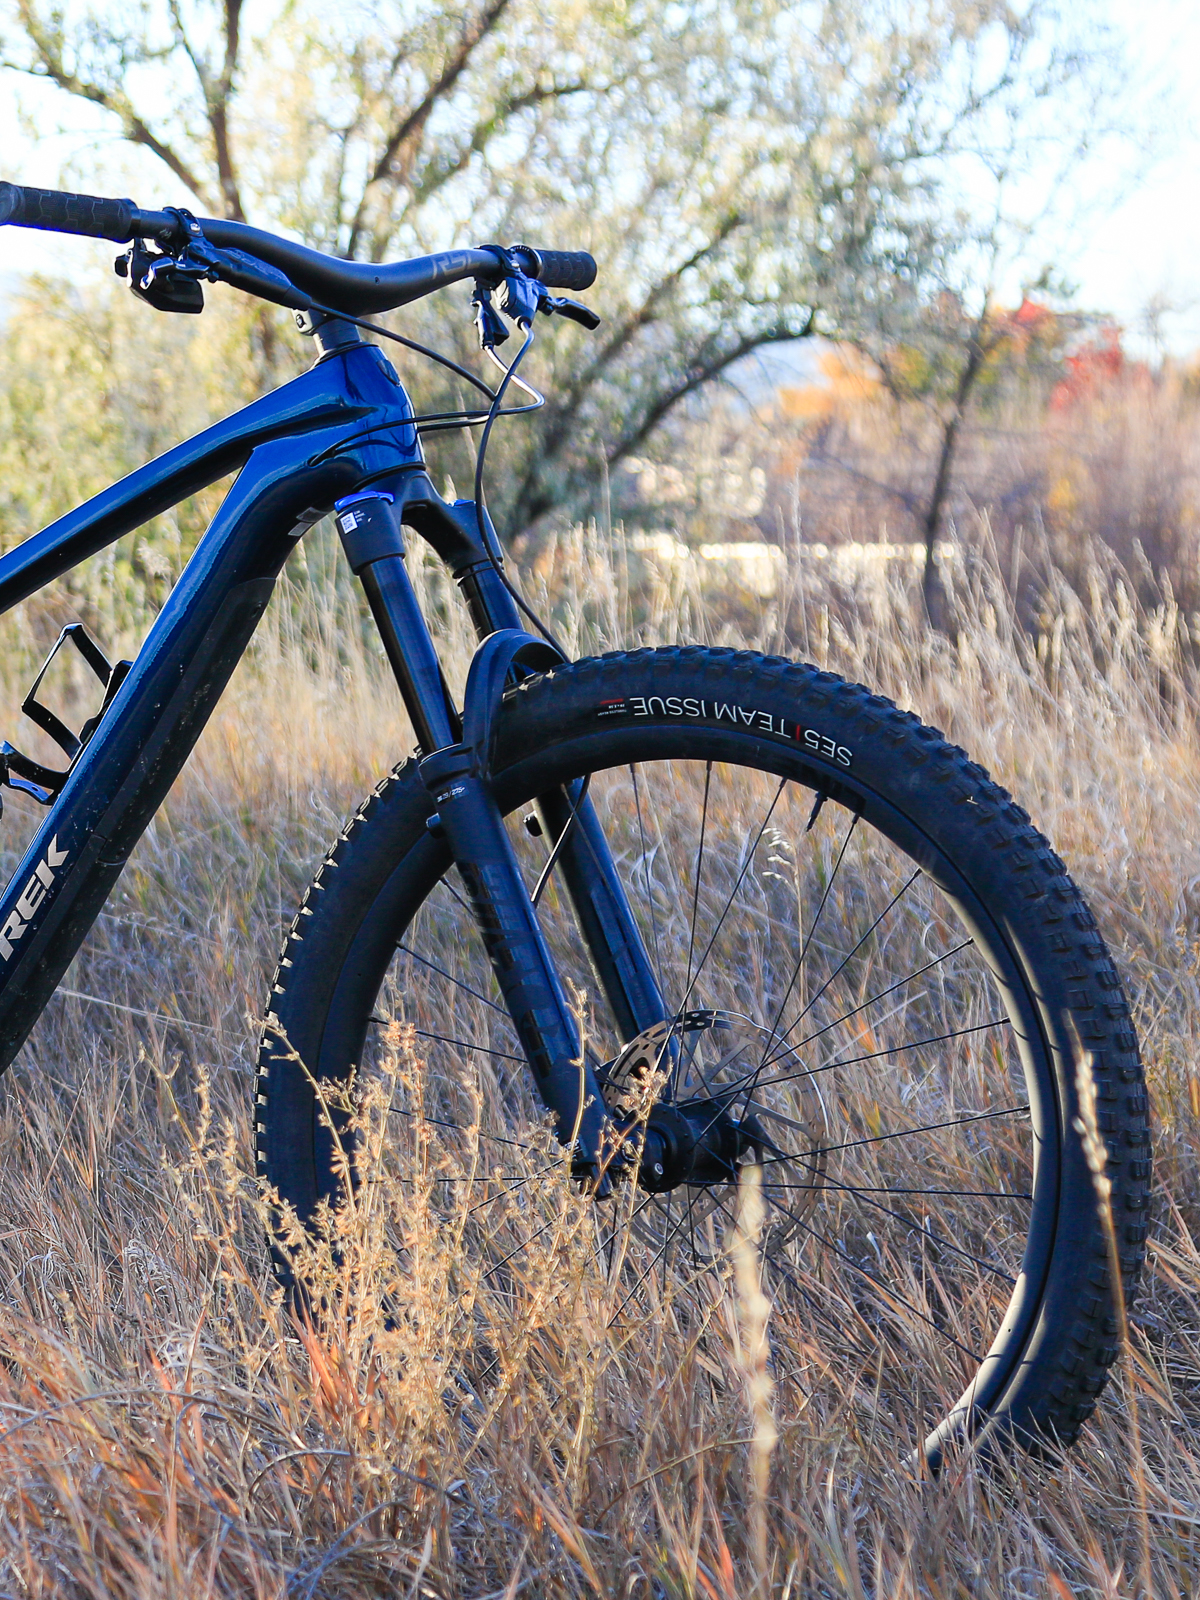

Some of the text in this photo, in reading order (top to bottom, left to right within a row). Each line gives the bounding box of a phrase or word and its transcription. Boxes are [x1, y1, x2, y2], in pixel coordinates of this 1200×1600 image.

[629, 696, 854, 767] SE5 TEAM ISSUE
